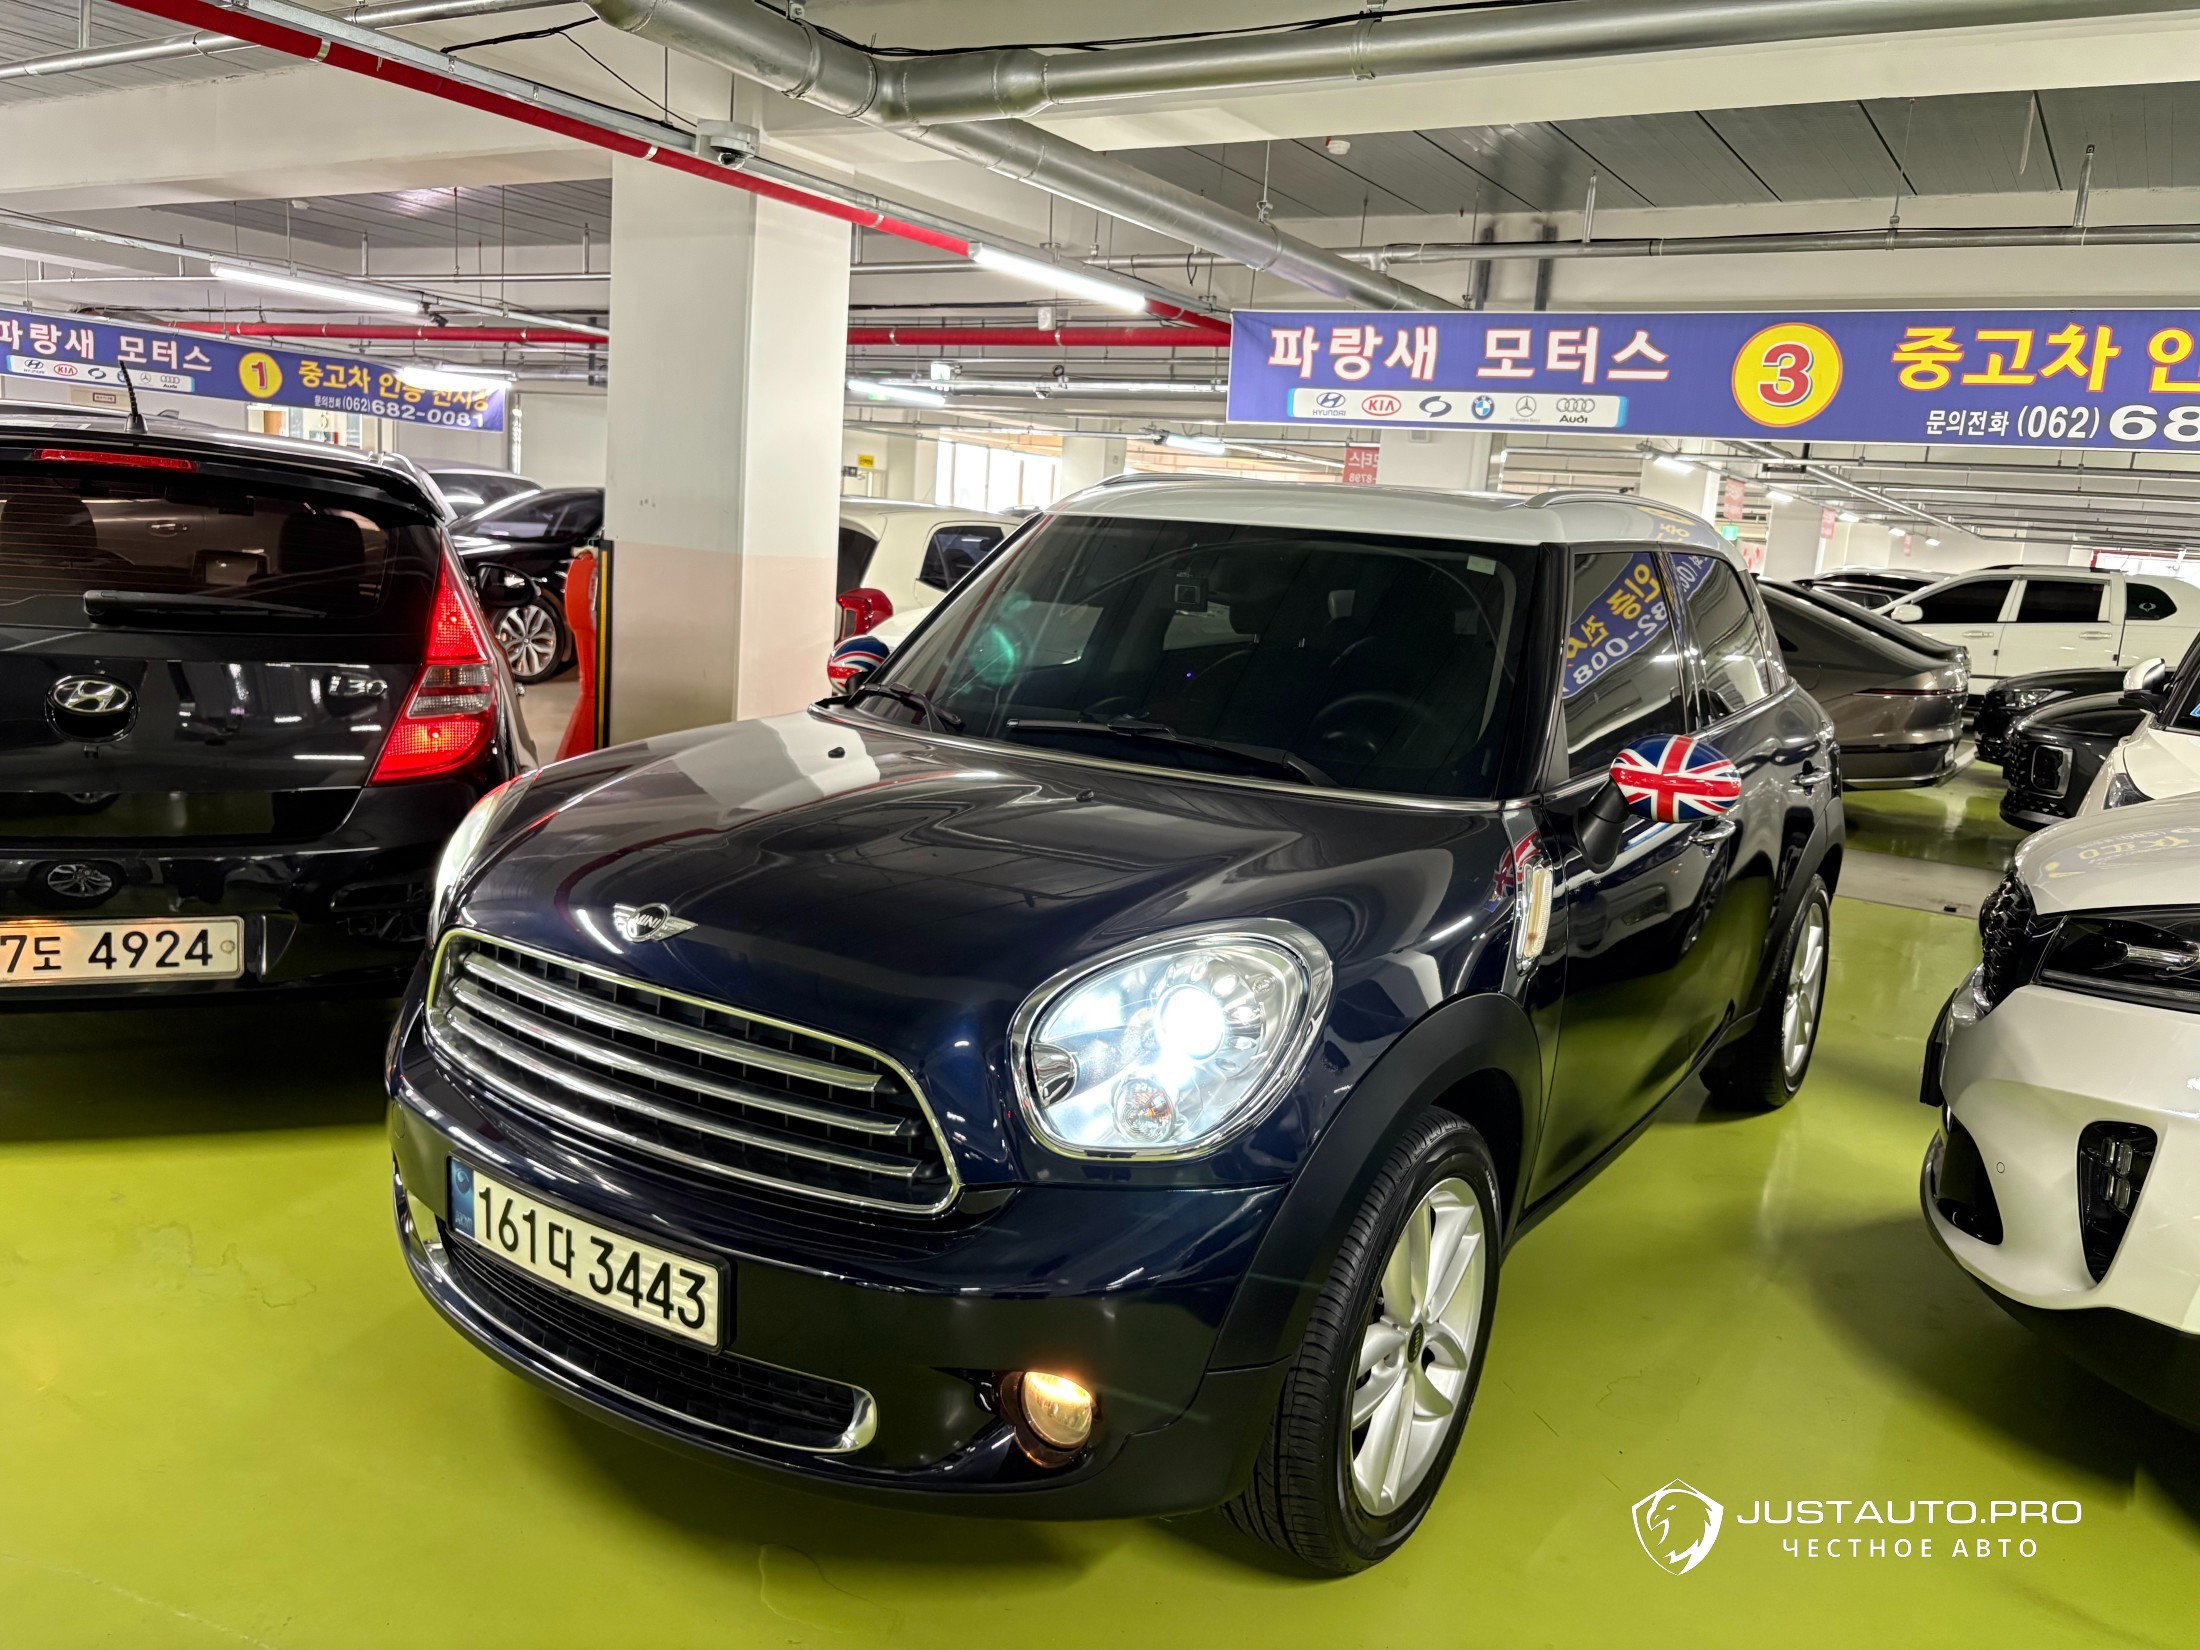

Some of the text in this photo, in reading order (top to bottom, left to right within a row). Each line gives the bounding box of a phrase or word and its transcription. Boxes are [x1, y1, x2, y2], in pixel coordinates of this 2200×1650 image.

[0, 319, 213, 372] 파랑새 모터스
[1268, 325, 1670, 385] 파랑새 모터스
[1891, 322, 2122, 393] 중고차
[57, 366, 74, 375] KIA
[251, 361, 267, 390] 1
[298, 360, 371, 394] 중고차
[1757, 341, 1814, 407] 3
[343, 395, 370, 413] (062)
[372, 399, 484, 428] 682-0081
[1312, 408, 1346, 417] HYUNDAI
[1368, 399, 1395, 412] KIA
[1559, 415, 1588, 423] Audi
[1925, 408, 2010, 437] 문의전화
[2017, 405, 2100, 440] (062)
[635, 912, 661, 928] MINI
[0, 929, 213, 973] 7도 4924
[478, 1186, 706, 1330] 161다 3443
